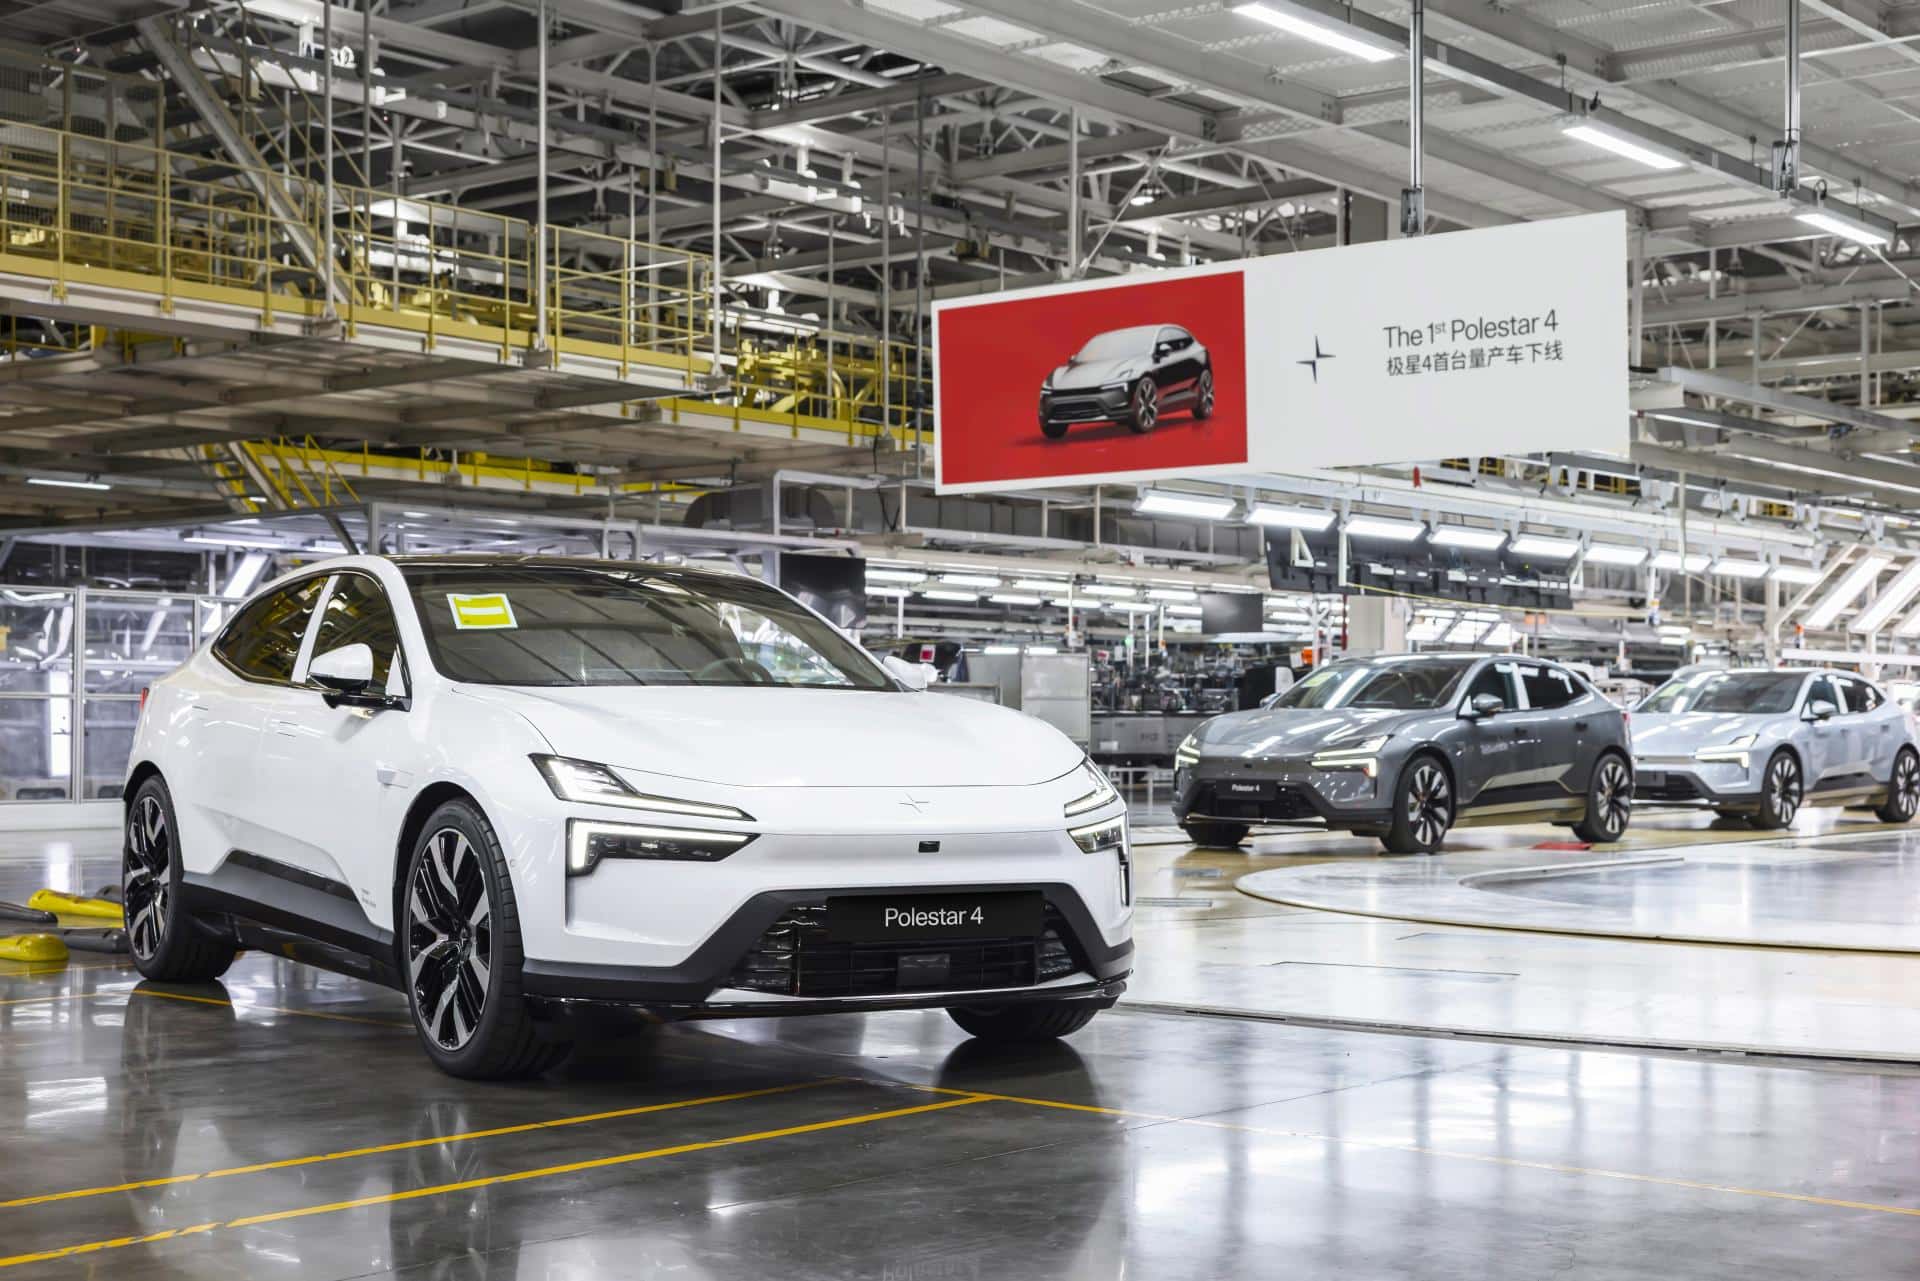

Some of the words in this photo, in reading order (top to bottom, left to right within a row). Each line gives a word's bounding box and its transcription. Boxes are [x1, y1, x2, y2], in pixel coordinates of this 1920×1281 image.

[1383, 325, 1423, 349] The
[1427, 321, 1447, 344] 1st
[1451, 315, 1540, 342] Polestar
[1543, 308, 1559, 332] 4
[1386, 340, 1564, 376] 极星4首台量产车下线
[885, 906, 968, 927] Polestar
[970, 906, 984, 925] 4
